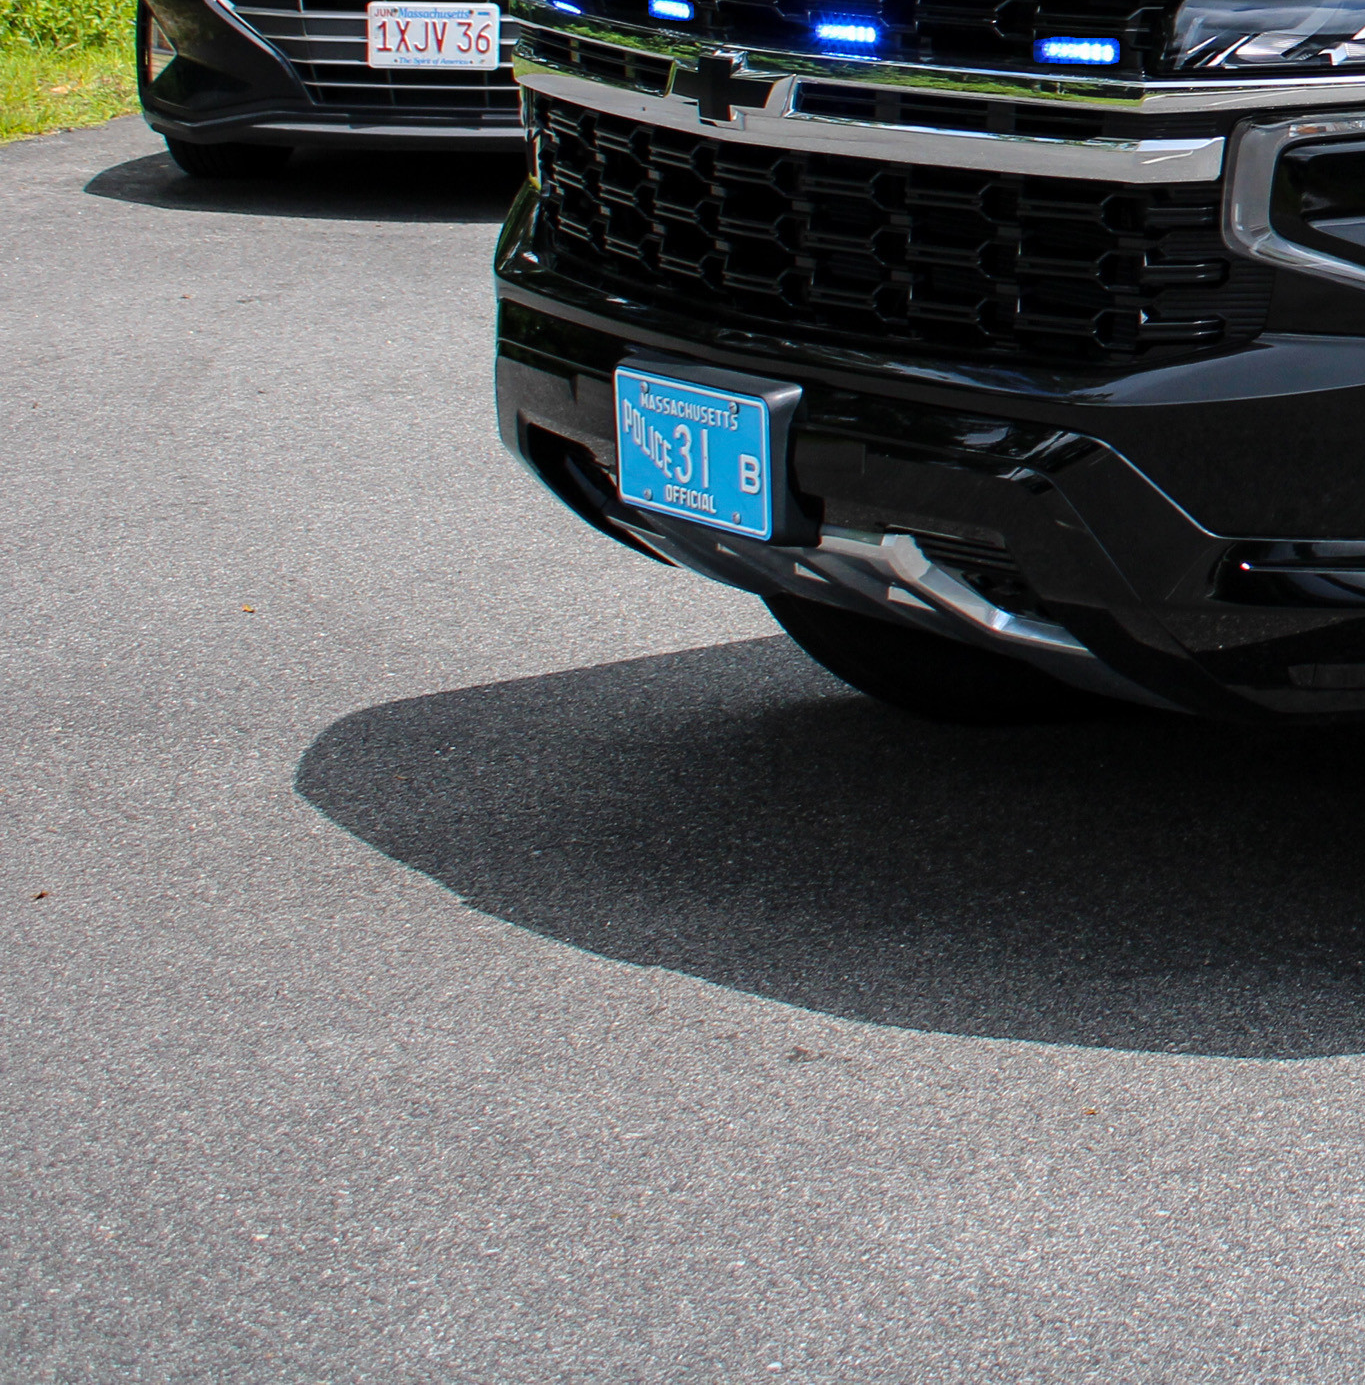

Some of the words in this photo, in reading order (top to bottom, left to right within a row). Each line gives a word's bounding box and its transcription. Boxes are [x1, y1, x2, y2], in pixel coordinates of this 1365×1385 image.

[398, 7, 470, 19] Massachusetts
[376, 20, 448, 53] 1XJV
[456, 20, 492, 54] 36
[640, 393, 738, 431] MASSACHUSETTS
[622, 398, 673, 479] POLICE
[673, 424, 709, 488] 31
[740, 453, 761, 495] B
[665, 483, 717, 514] OFFICIAL
